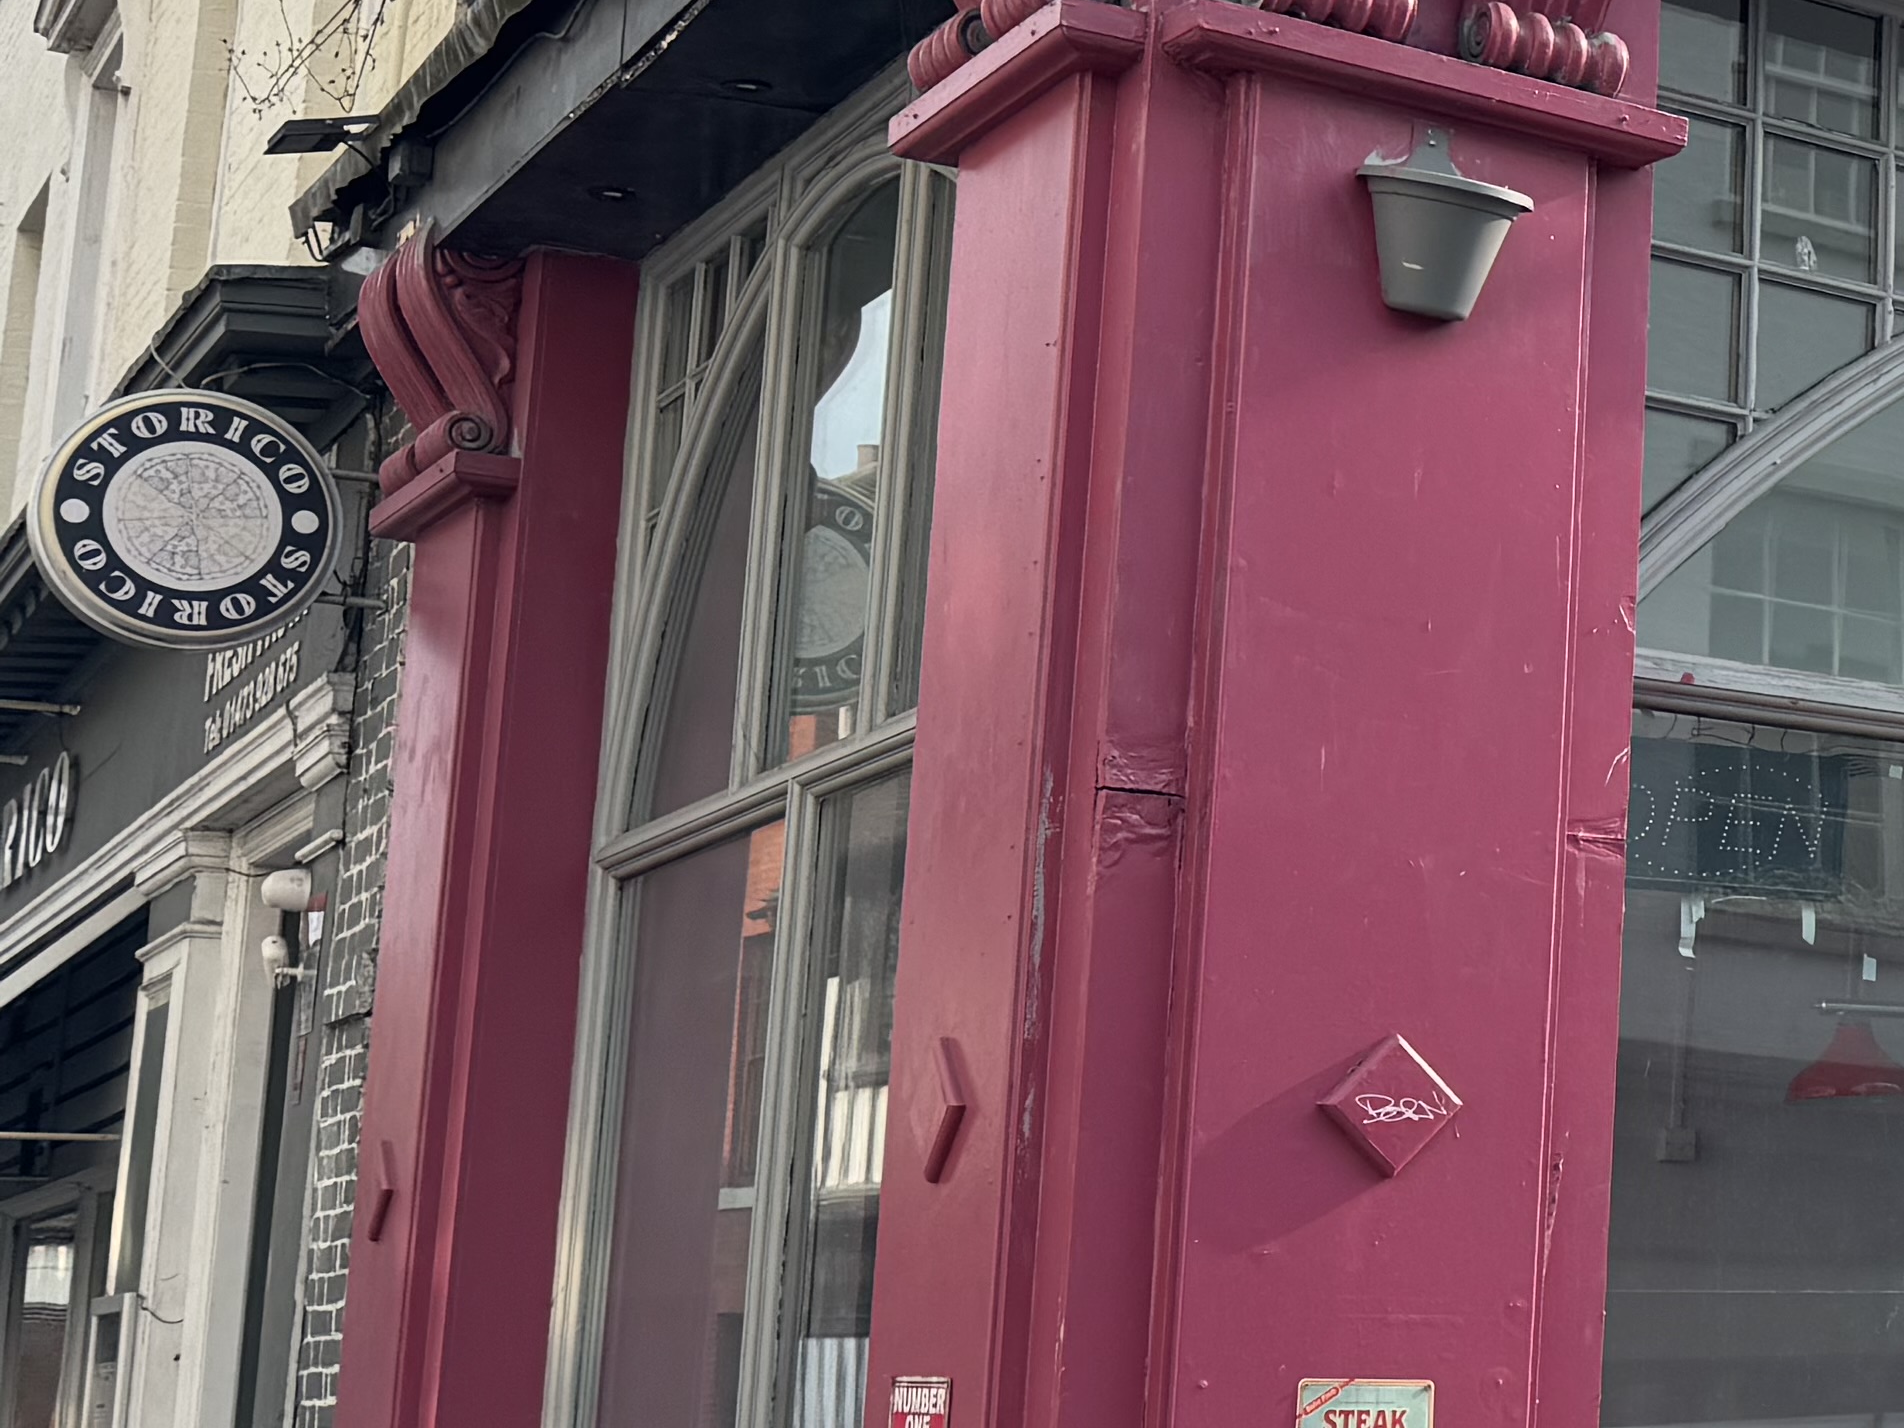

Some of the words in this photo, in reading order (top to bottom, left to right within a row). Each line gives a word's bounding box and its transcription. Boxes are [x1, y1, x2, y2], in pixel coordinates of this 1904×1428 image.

[73, 407, 310, 495] STORICO
[73, 538, 312, 626] STORICO
[893, 1386, 946, 1415] NUMBER
